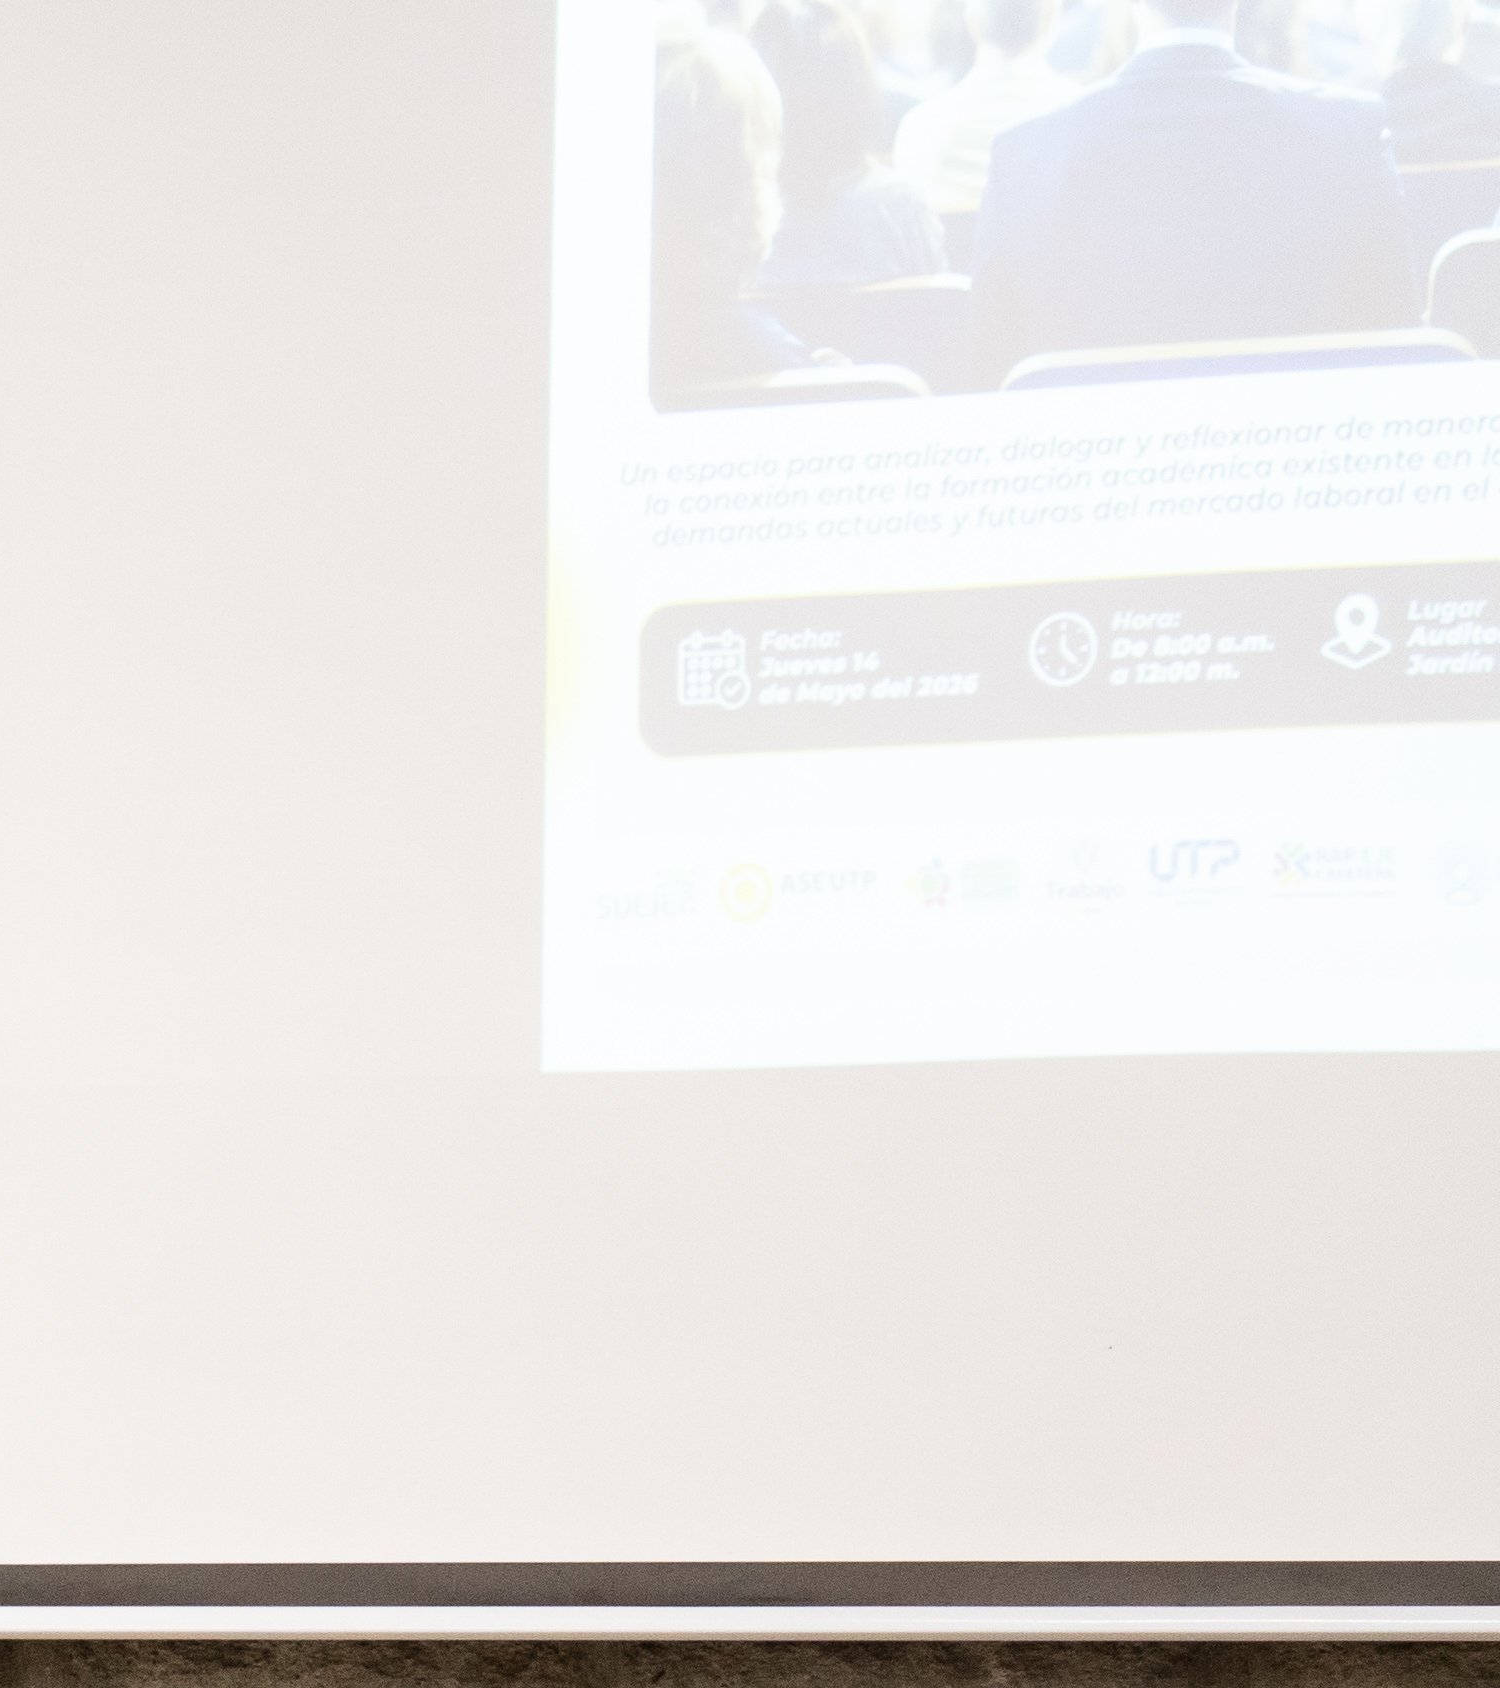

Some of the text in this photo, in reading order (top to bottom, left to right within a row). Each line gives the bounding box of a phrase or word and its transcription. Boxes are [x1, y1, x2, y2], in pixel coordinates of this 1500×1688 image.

[619, 463, 658, 487] Un
[666, 458, 779, 485] espacio
[786, 454, 856, 479] para
[864, 443, 990, 471] analizar,
[1000, 435, 1127, 462] dialogar
[1135, 434, 1153, 459] y
[1160, 424, 1326, 451] reflexionar
[1332, 414, 1374, 442] de
[643, 493, 670, 516] la
[679, 488, 809, 514] conexión
[817, 483, 895, 506] entre
[904, 478, 932, 501] la
[940, 471, 1092, 498] formación
[1101, 459, 1273, 488] académica
[1282, 449, 1424, 477] existente
[1433, 449, 1473, 470] en
[651, 476, 1491, 549] demandas actuales y futuras del mercado laboral en el
[1111, 611, 1182, 630] Hora:
[1407, 599, 1487, 623] Lugar
[760, 627, 843, 651] Fecha:
[1110, 632, 1276, 659] De 8:00 a.m.
[758, 650, 881, 678] Jueves 14
[1109, 659, 1241, 686] a 12:00 m.
[1406, 650, 1494, 676] Jardín
[758, 670, 980, 708] de Mayo del 2026
[1147, 837, 1243, 883] UTP
